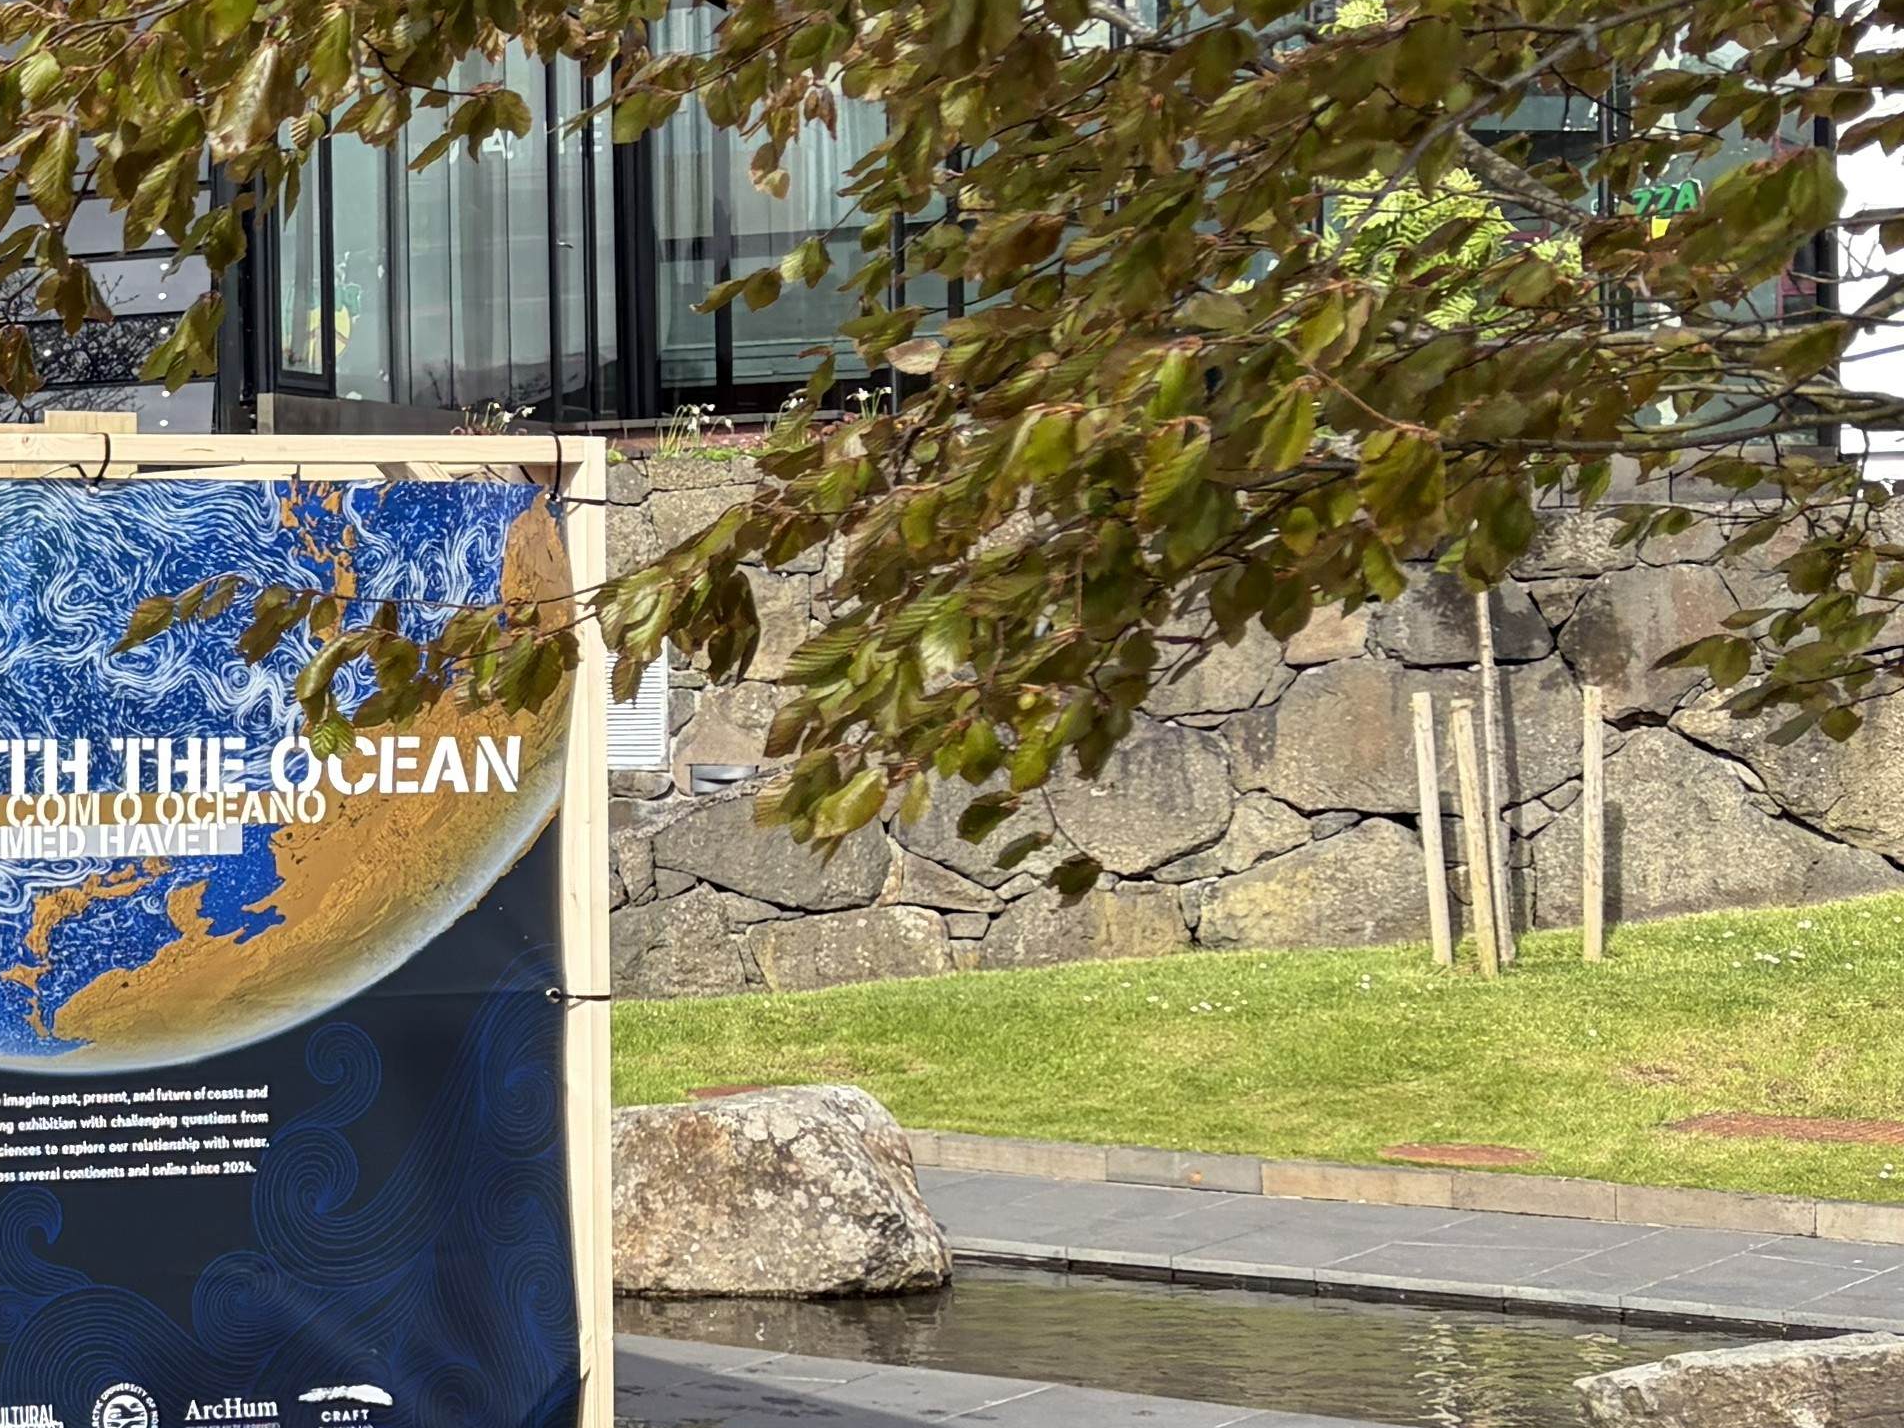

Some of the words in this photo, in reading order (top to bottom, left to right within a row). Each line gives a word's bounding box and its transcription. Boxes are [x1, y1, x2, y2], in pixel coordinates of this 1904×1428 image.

[112, 736, 248, 793] THE
[270, 735, 522, 796] OCEAN
[6, 793, 100, 827] COM
[113, 791, 143, 825] O
[154, 789, 327, 825] OCEANO
[0, 825, 87, 859] MED
[99, 823, 223, 856] HAVET
[3, 1092, 50, 1109] imagine
[51, 1092, 81, 1108] past,
[82, 1090, 132, 1107] present,
[133, 1088, 156, 1103] and
[156, 1087, 192, 1102] future
[193, 1086, 207, 1100] of
[207, 1087, 244, 1100] coasts
[246, 1085, 269, 1099] and
[17, 1116, 77, 1132] exhibition
[79, 1114, 108, 1128] with
[110, 1113, 178, 1129] challenging
[181, 1111, 238, 1128] questions
[241, 1110, 269, 1123] from
[44, 1143, 59, 1155] to
[61, 1140, 106, 1157] explore
[108, 1142, 129, 1154] our
[131, 1136, 200, 1154] relationship
[202, 1135, 230, 1149] with
[232, 1136, 270, 1149] water.
[18, 1166, 61, 1182] several
[62, 1164, 125, 1180] continents
[127, 1162, 150, 1177] and
[152, 1162, 188, 1177] online
[190, 1161, 220, 1175] since
[222, 1160, 257, 1174] 2024.
[184, 1397, 279, 1421] ArcHum
[320, 1408, 371, 1423] CRAFT
